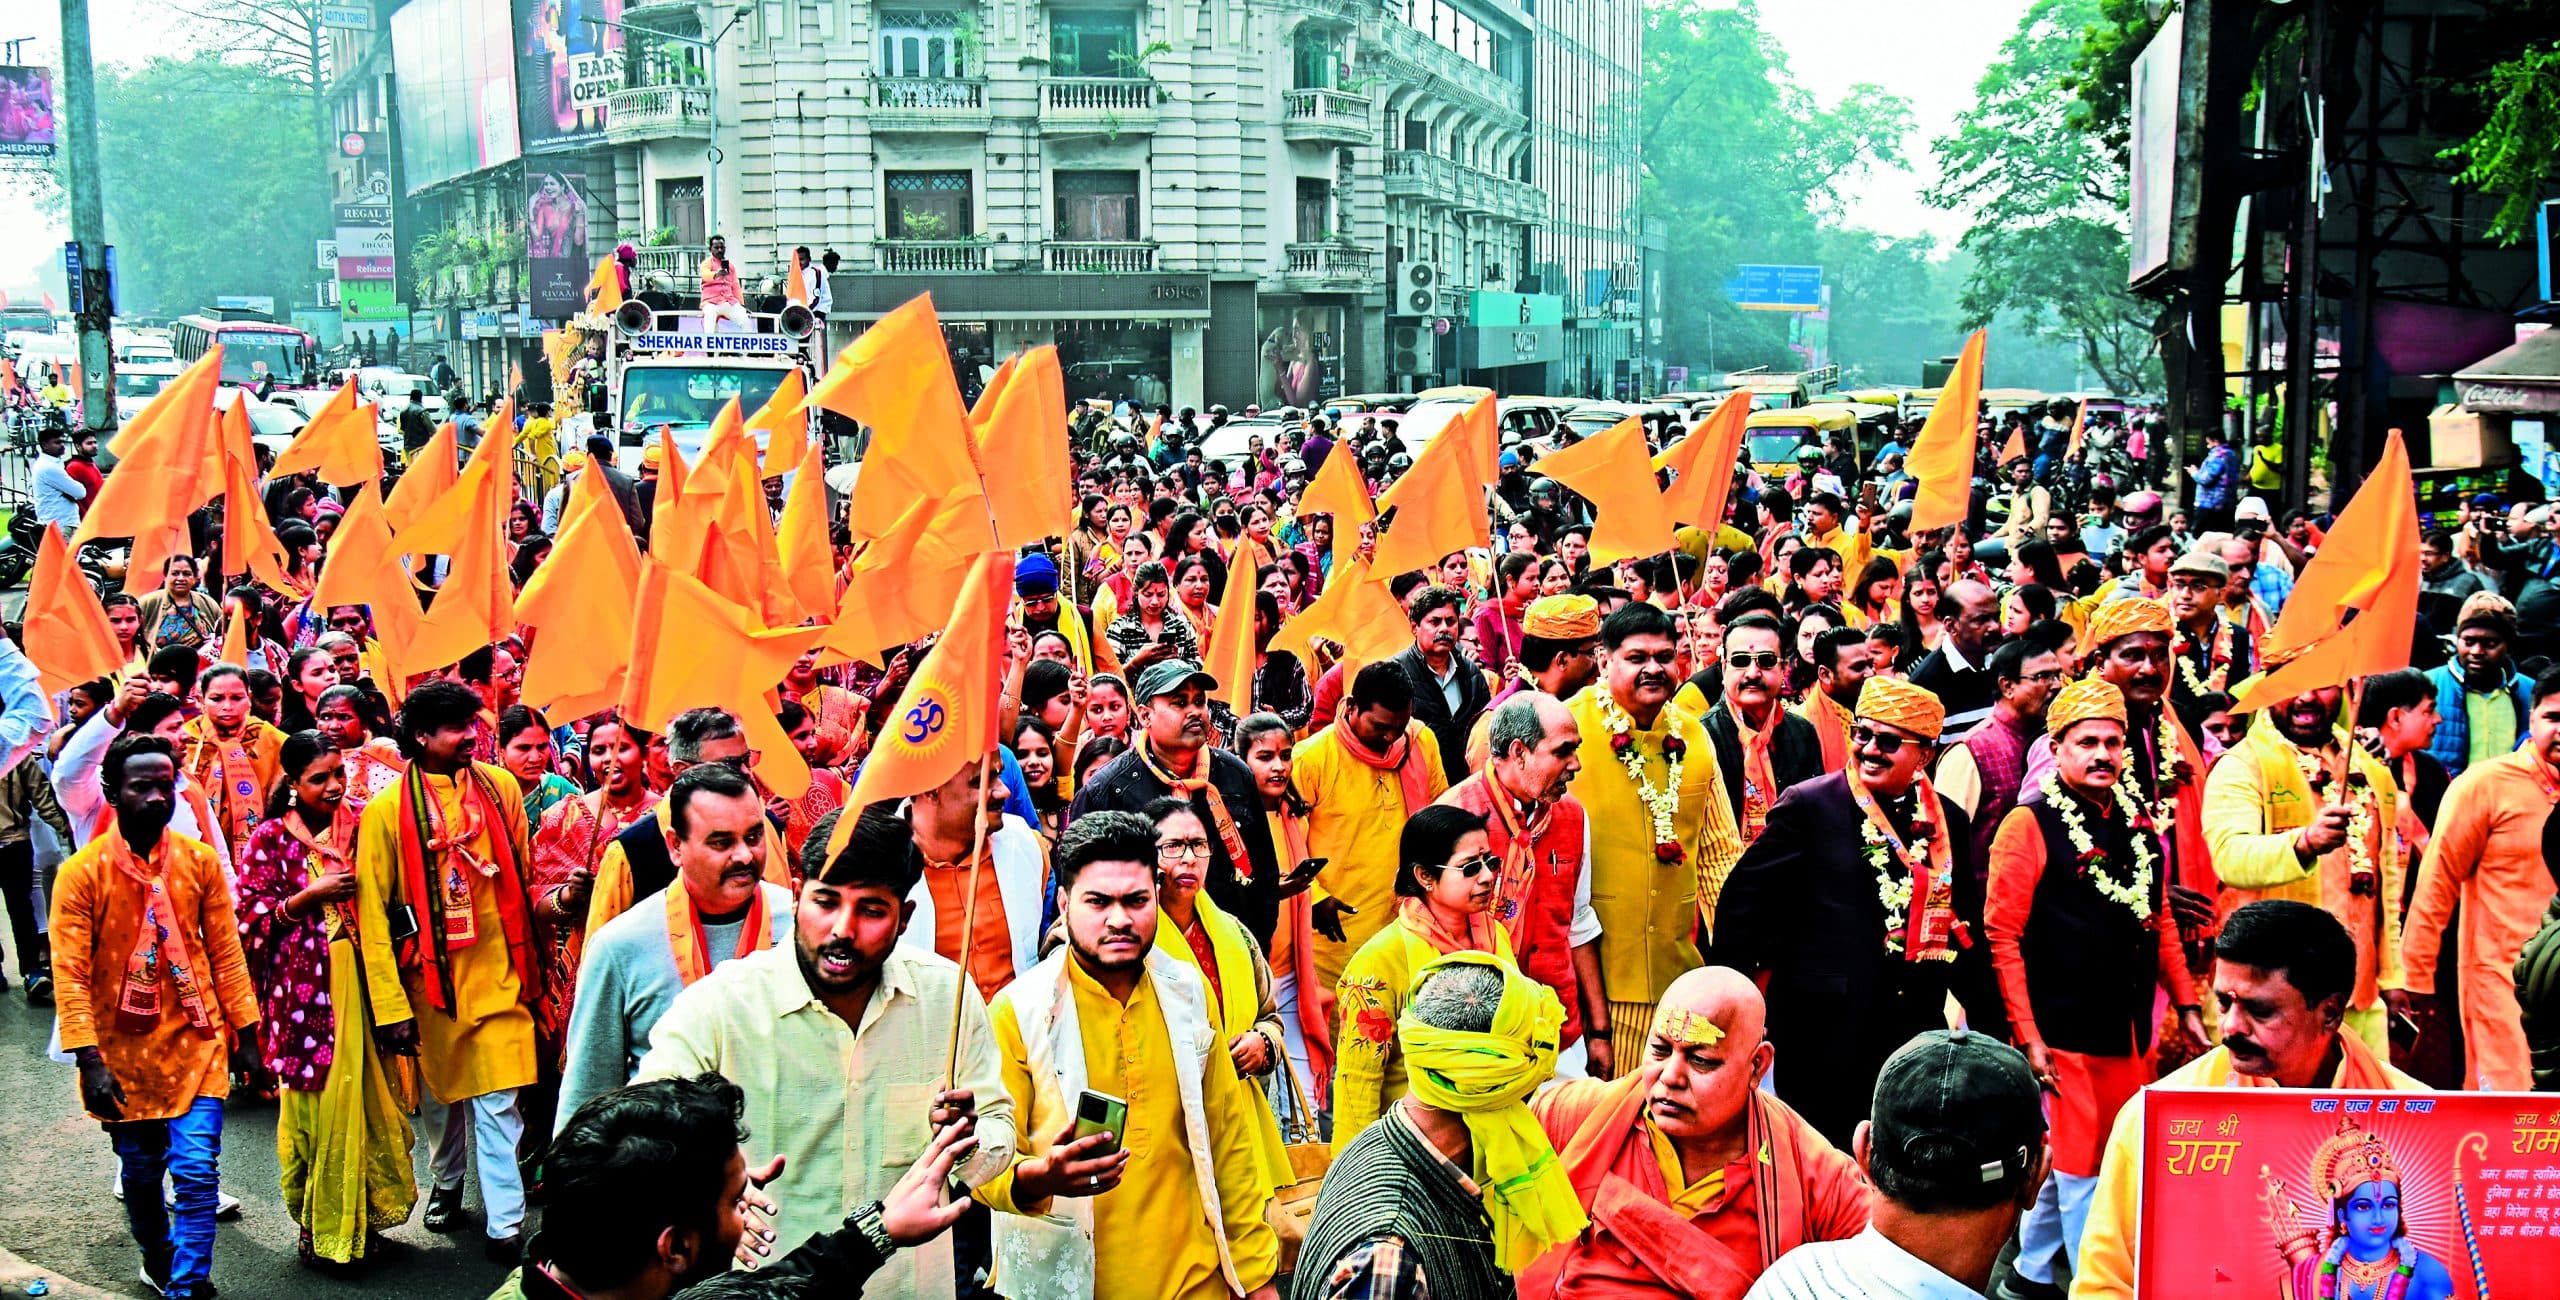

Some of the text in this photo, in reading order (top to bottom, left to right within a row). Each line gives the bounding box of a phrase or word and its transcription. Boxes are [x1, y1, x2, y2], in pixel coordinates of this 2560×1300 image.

[325, 10, 368, 24] ADITYA TOWER
[578, 58, 614, 78] BAR
[573, 78, 618, 101] OPEN
[344, 208, 381, 219] REGAL
[356, 264, 392, 273] Reliance
[364, 306, 385, 314] MEGA
[638, 335, 788, 351] SHEKHAR ENTERPISES
[2311, 1099, 2436, 1113] राम राज आ गया
[2169, 1113, 2241, 1137] जय श्री
[2514, 1113, 2540, 1126] जय
[2511, 1128, 2560, 1154] राम
[2166, 1140, 2243, 1176] राम
